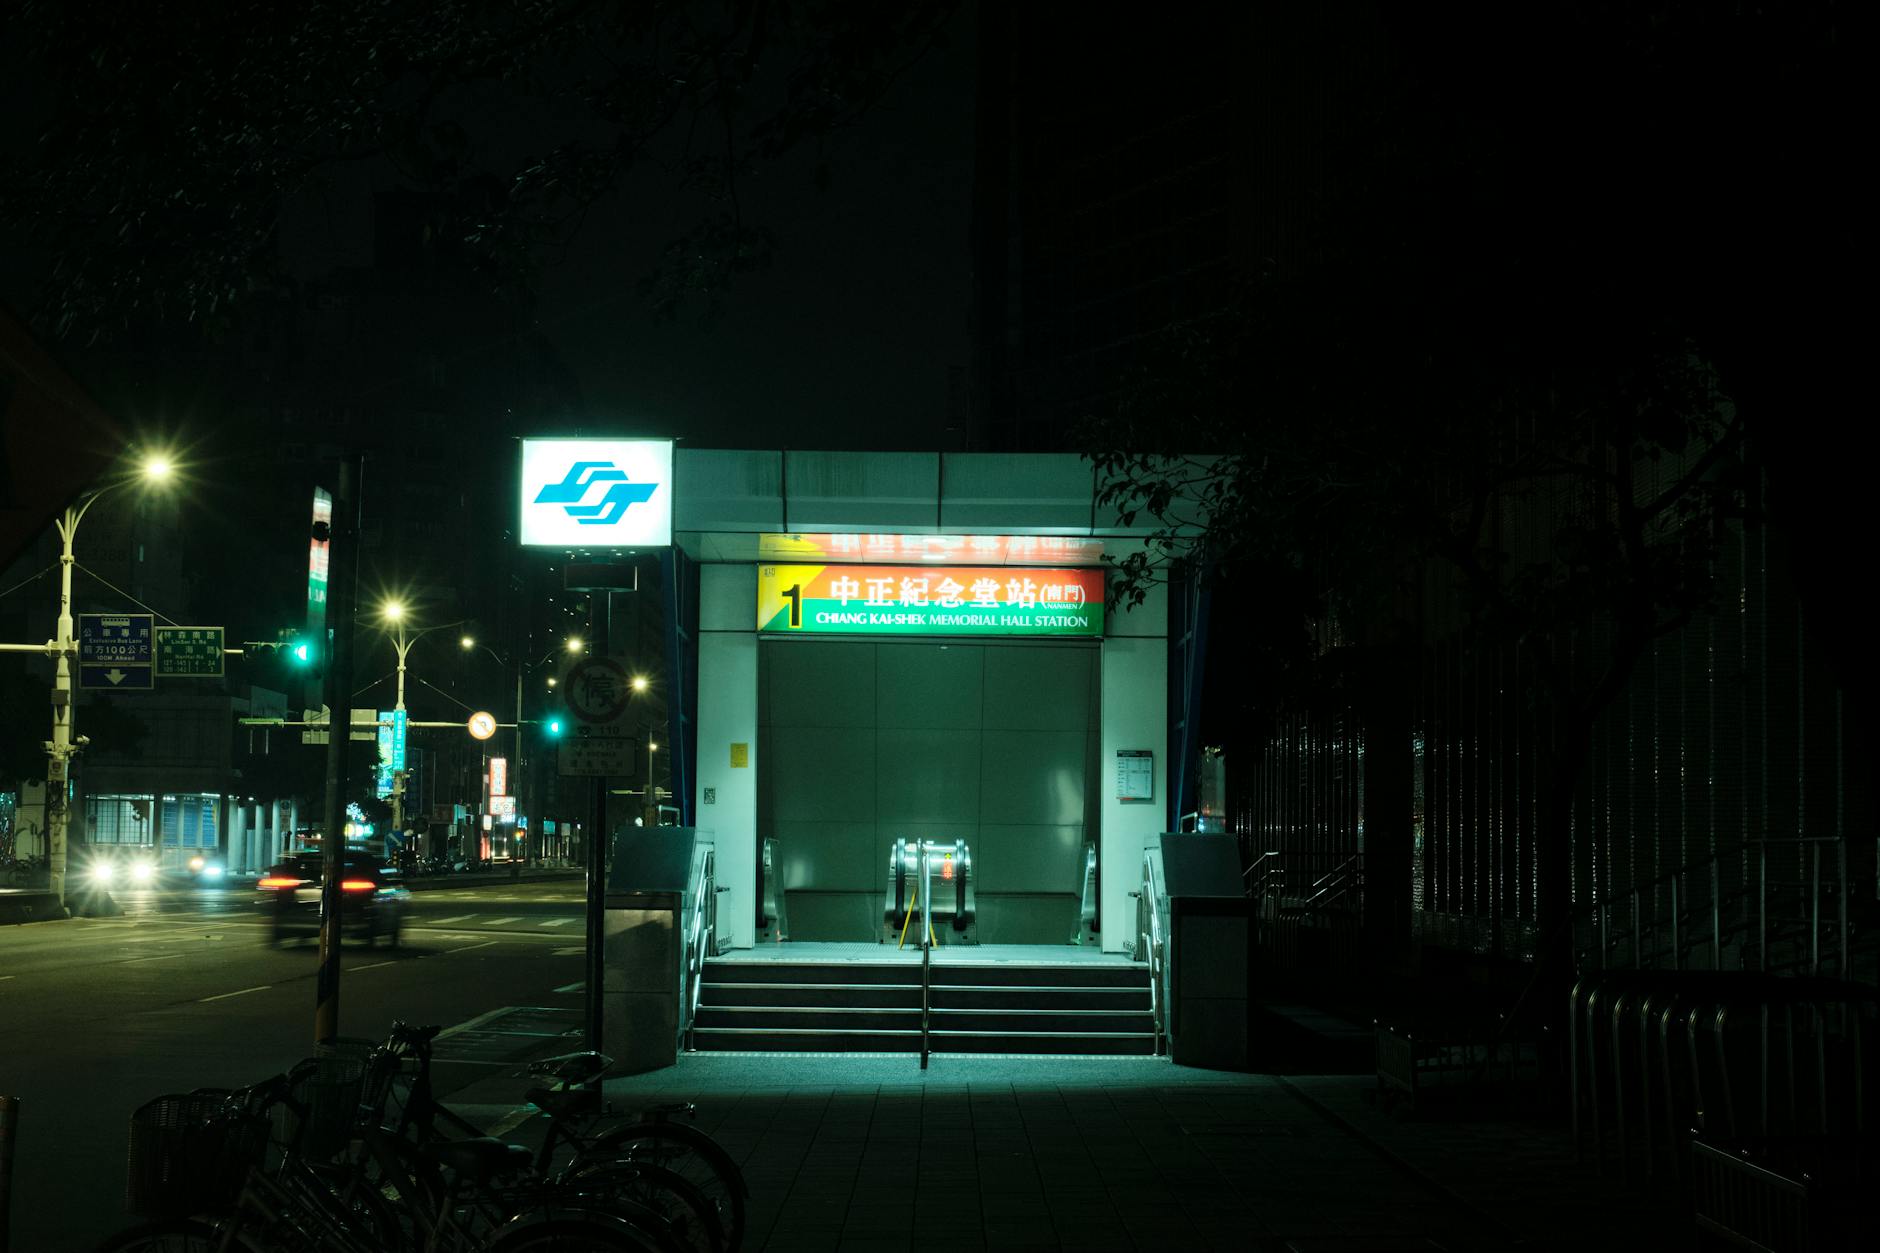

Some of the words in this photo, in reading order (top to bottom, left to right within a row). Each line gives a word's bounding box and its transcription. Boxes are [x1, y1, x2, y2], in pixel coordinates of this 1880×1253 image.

[831, 575, 1036, 609] 中正紀念堂站
[782, 584, 803, 628] 1
[1046, 602, 1078, 610] NANMEN
[815, 611, 868, 625] CHIANG
[869, 612, 926, 625] KAI-SHEK
[928, 613, 999, 626] MEMORIAL
[1000, 614, 1033, 626] HALL
[1034, 615, 1088, 627] STATION
